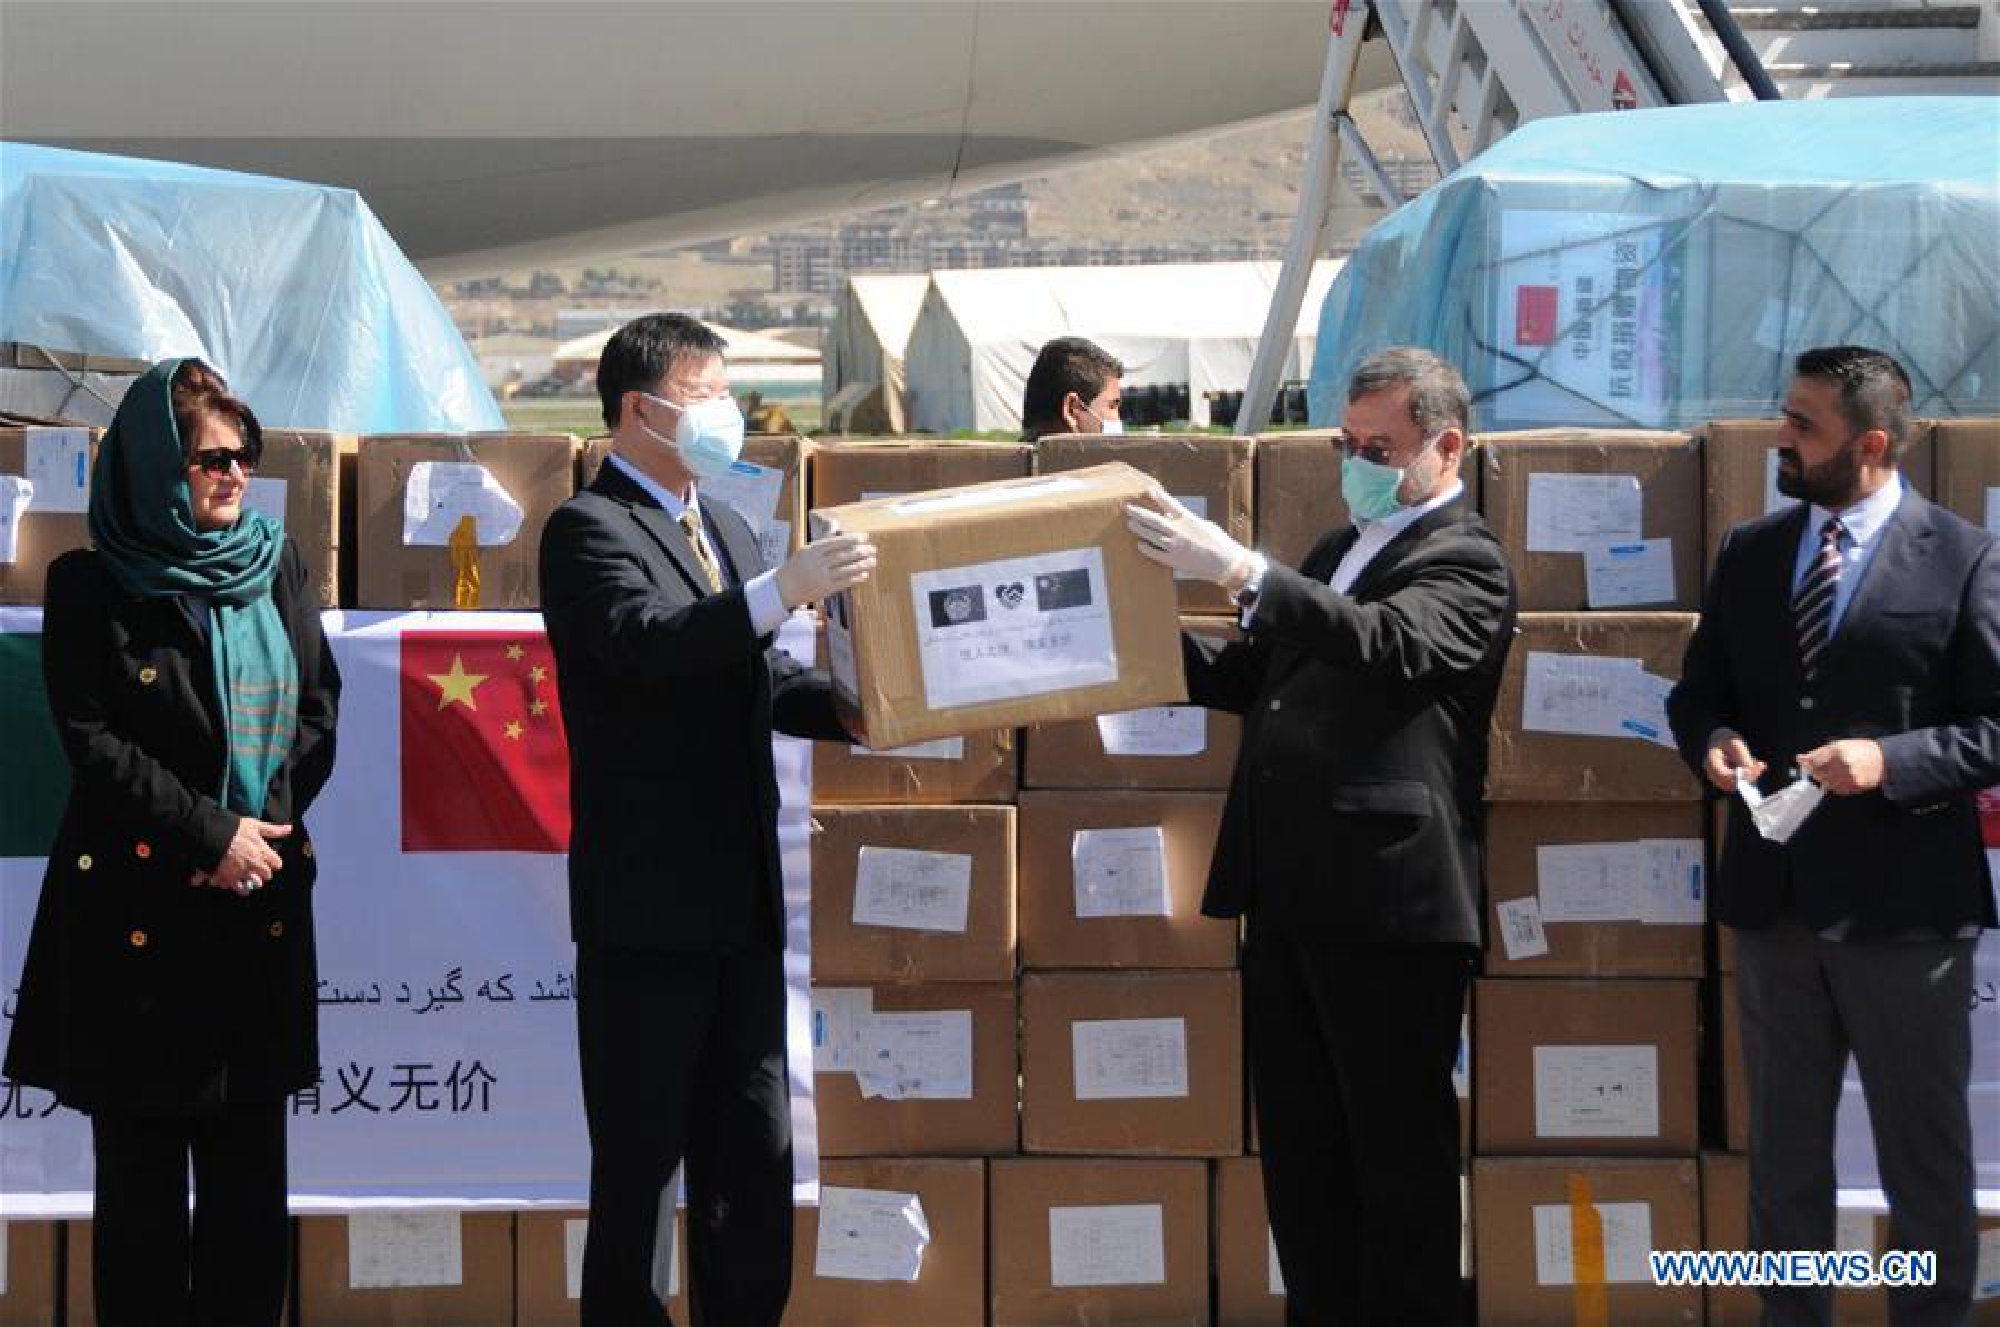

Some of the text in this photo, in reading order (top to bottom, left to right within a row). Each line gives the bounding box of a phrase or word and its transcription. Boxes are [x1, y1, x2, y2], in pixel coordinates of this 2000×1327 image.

[396, 966, 463, 1014] گیرد
[477, 973, 514, 1001] که
[530, 971, 578, 1002] اشد
